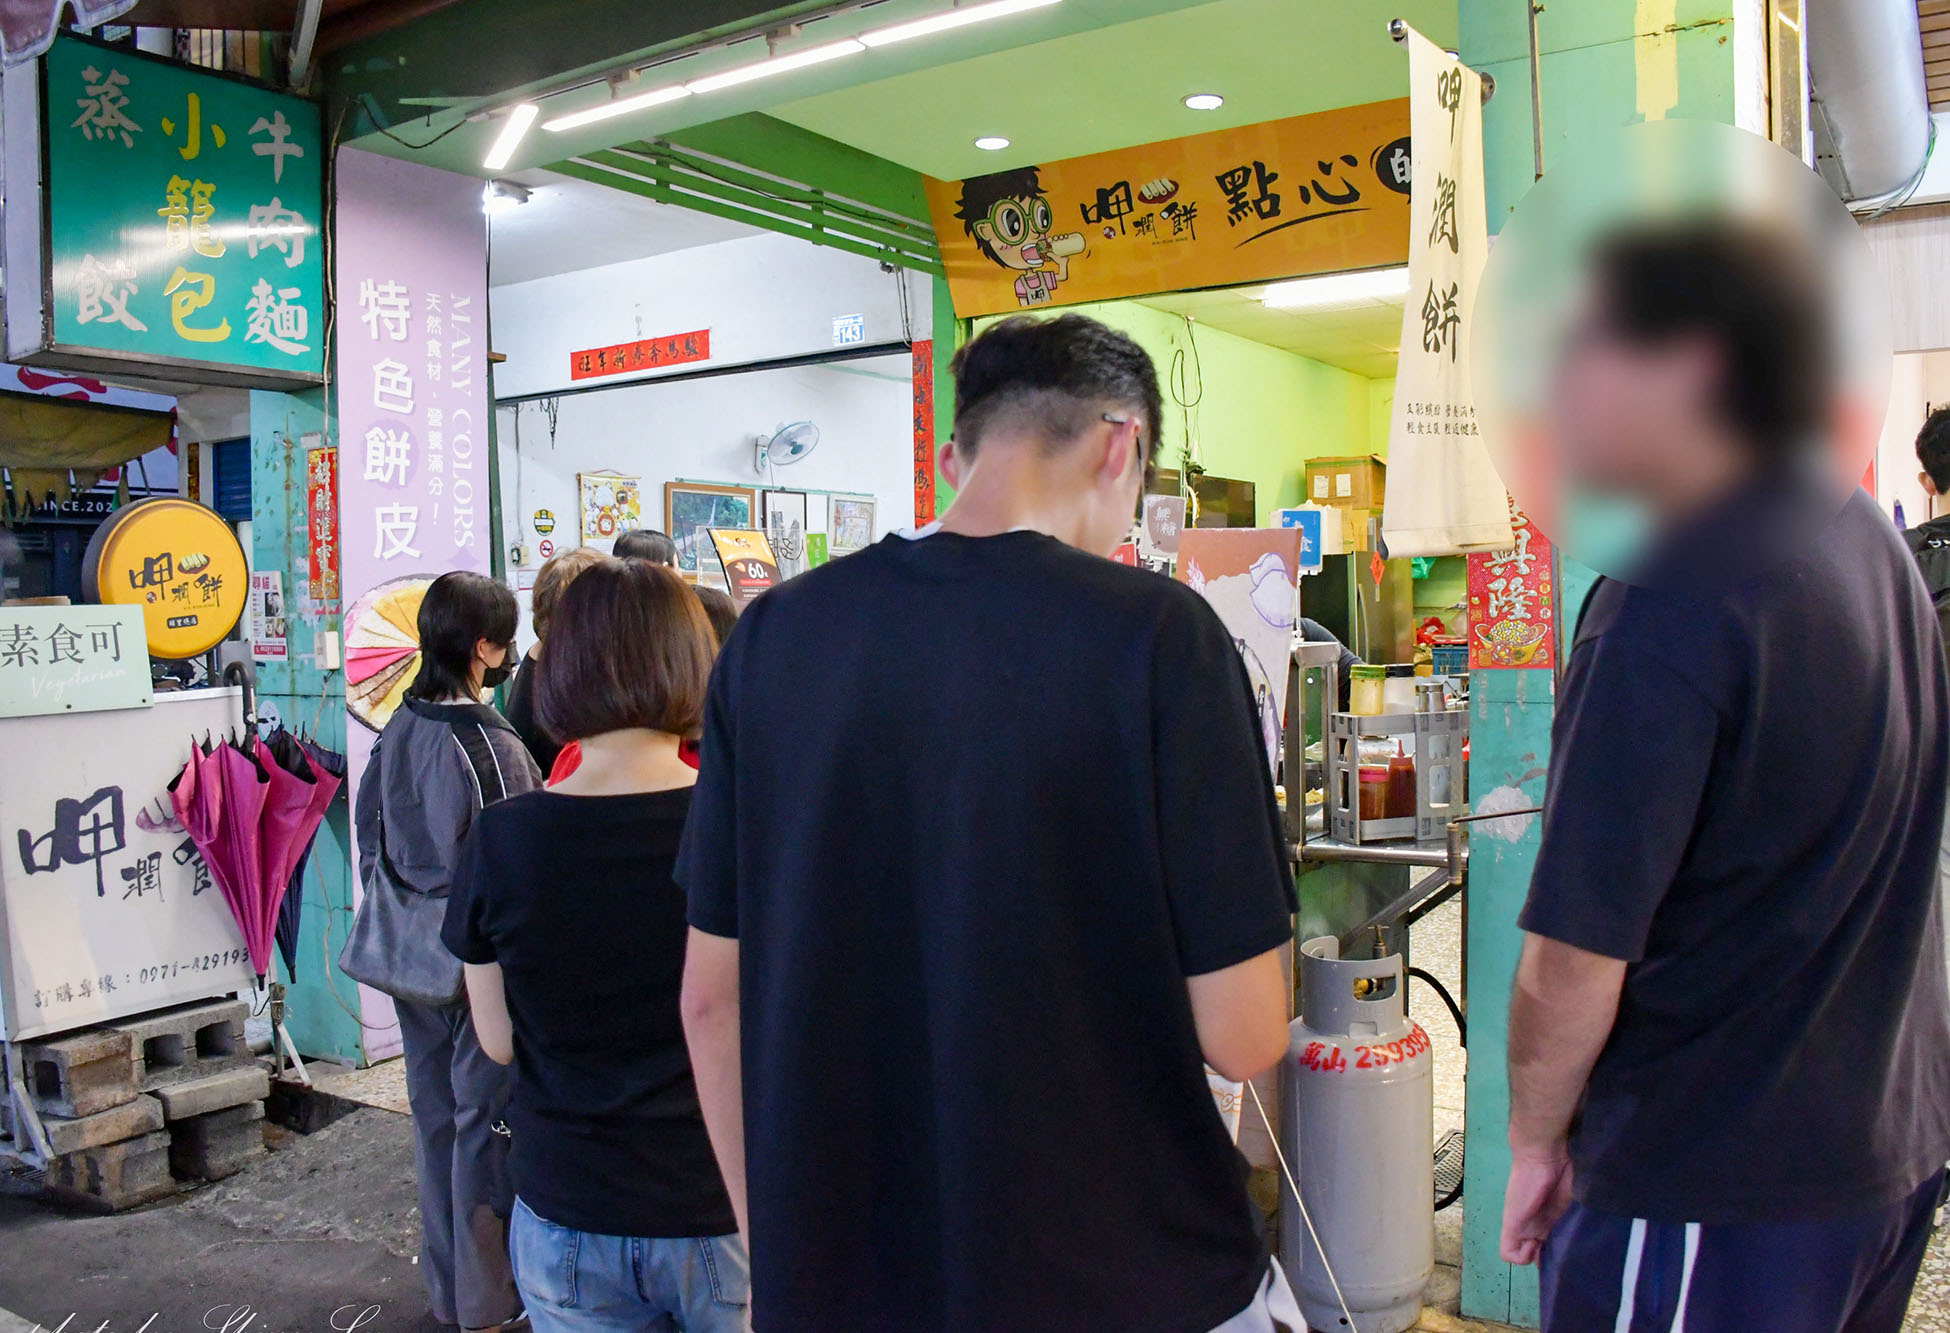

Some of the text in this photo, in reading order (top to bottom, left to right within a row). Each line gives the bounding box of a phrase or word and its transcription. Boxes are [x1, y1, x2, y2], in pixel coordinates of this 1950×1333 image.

[71, 65, 148, 332] 蒸餃
[158, 93, 231, 342] 小籠包
[244, 110, 310, 355] 牛肉麵
[1080, 181, 1198, 241] 呷潤餅
[1214, 153, 1361, 227] 點心
[1421, 66, 1463, 364] 呷潤餅
[359, 278, 421, 560] 特色餅皮
[450, 292, 476, 549] MANY COLORS
[0, 621, 123, 668] 素食可
[31, 666, 127, 703] Vegetarian
[129, 552, 223, 608] 呷潤餅
